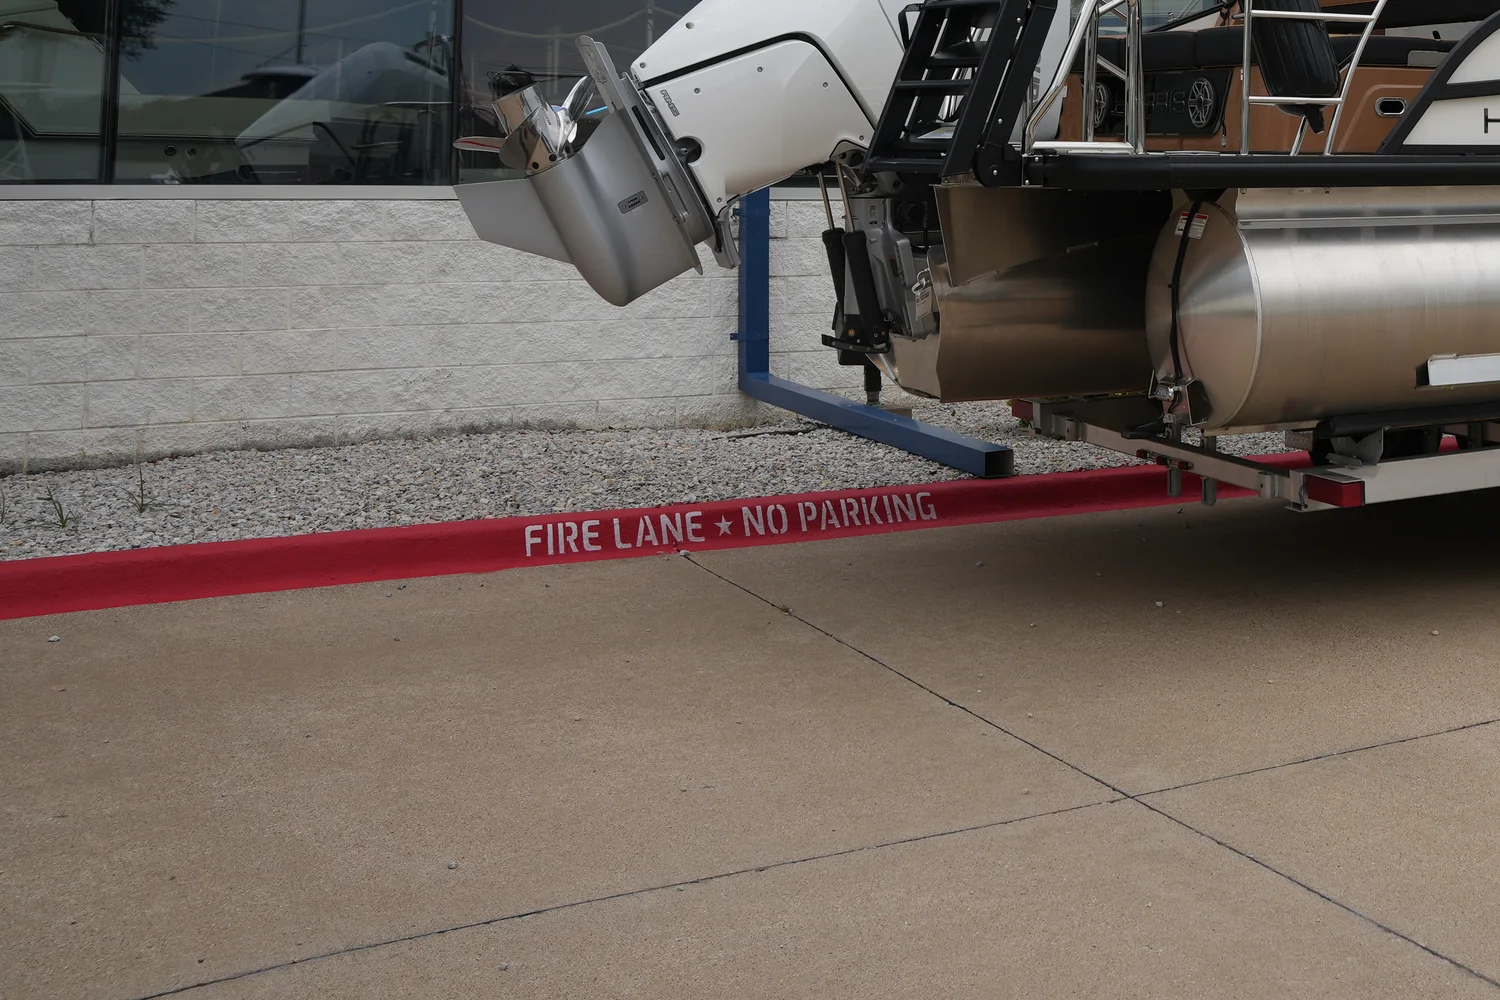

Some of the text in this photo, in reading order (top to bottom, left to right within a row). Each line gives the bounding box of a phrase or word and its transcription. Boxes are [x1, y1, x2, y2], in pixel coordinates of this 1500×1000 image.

[524, 491, 938, 557] FIRE LANE NO PARKING
